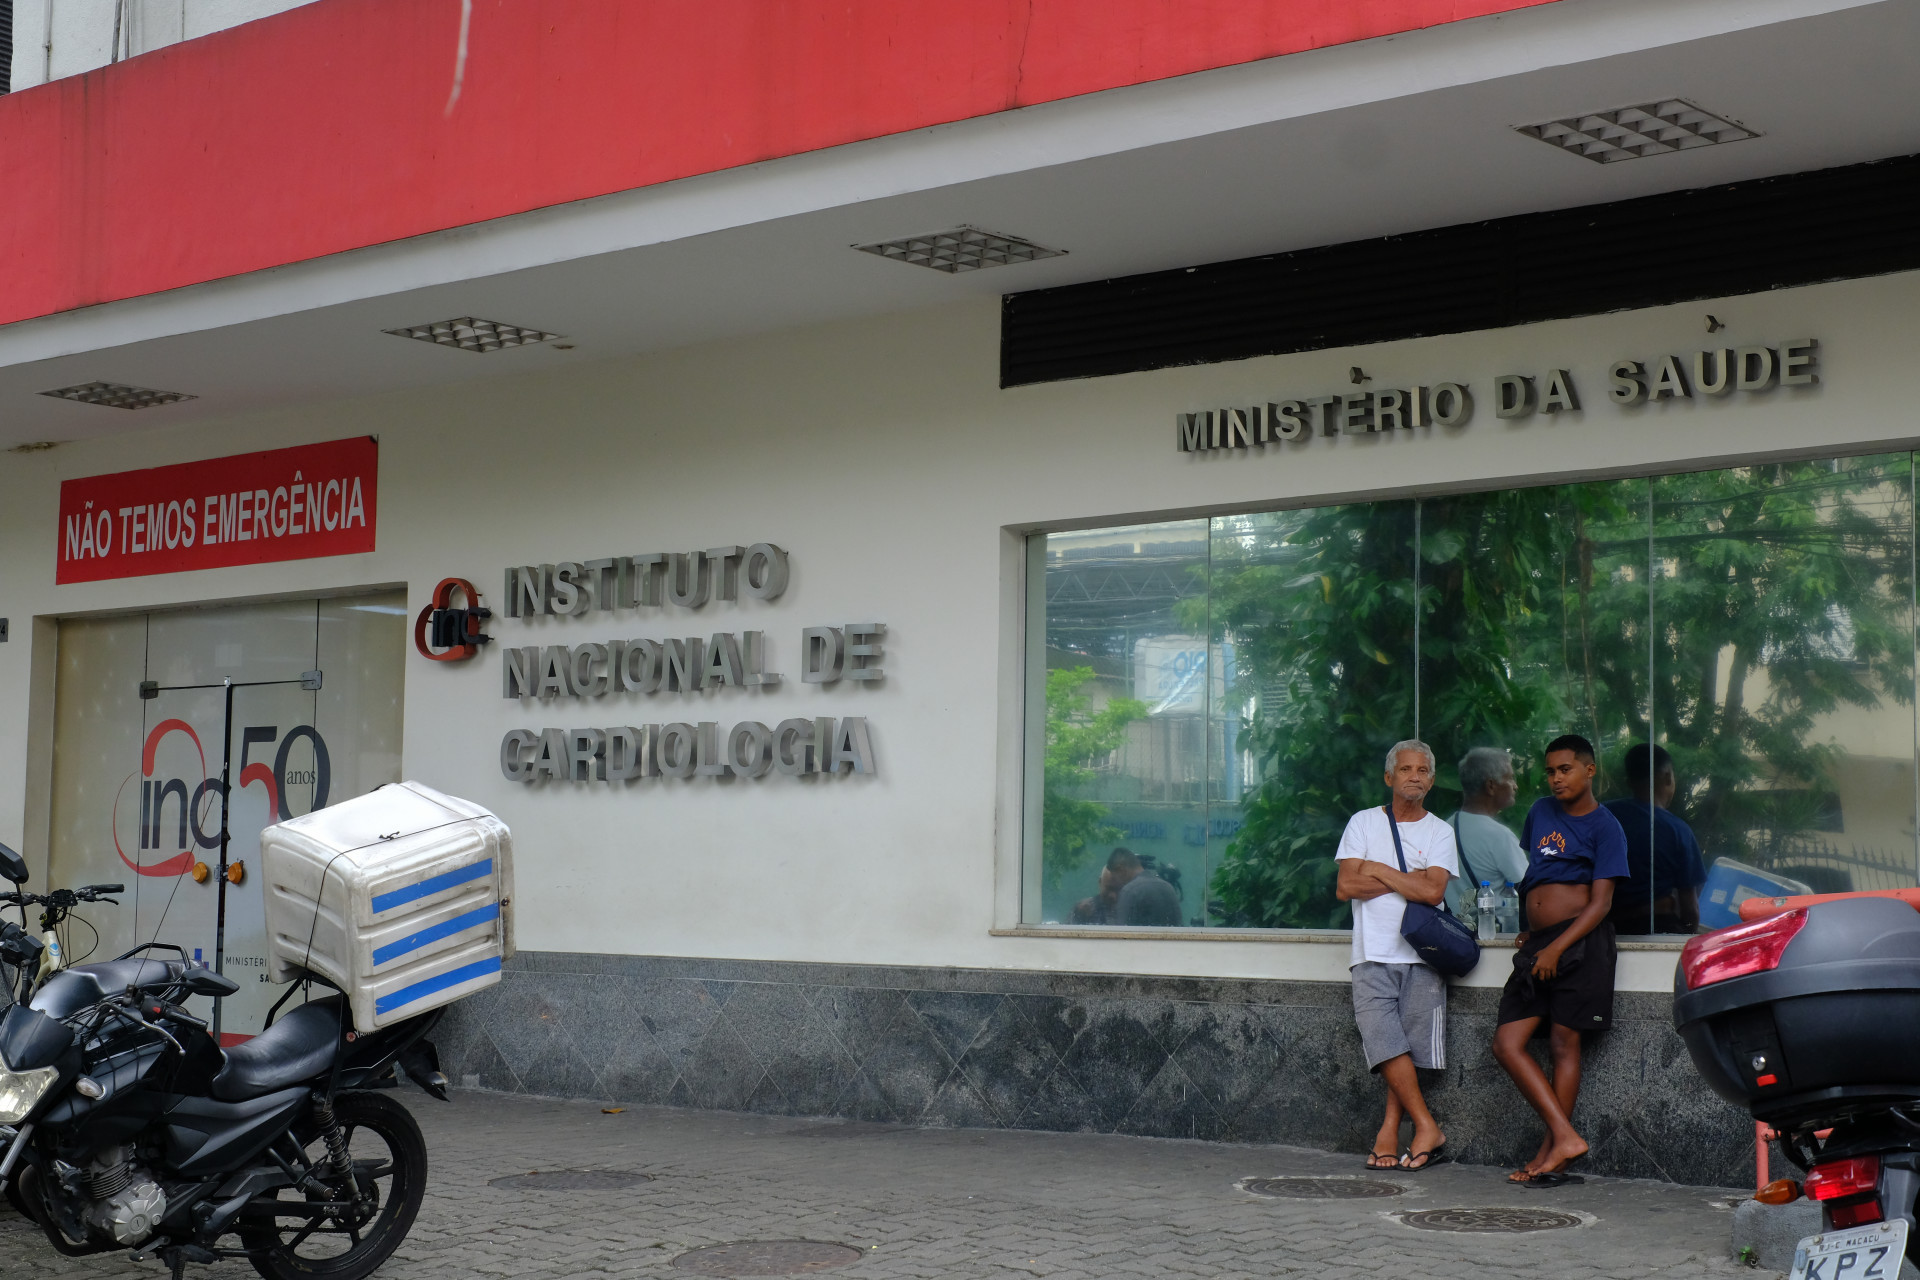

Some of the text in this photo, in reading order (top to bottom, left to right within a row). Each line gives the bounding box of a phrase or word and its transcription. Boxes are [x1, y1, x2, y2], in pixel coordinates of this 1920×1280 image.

[1177, 314, 1819, 453] MINISTÉRIO DA SAÚDE
[65, 470, 366, 561] NÃO TEMOS EMERGÊNCIA
[504, 542, 789, 618] INSTITUTO
[502, 623, 886, 699] NACIONAL DE
[240, 725, 331, 826] 50
[286, 769, 316, 786] anos
[500, 716, 875, 782] CARDIOLOGIA
[225, 956, 267, 968] MINISTÉRI
[1804, 1246, 1890, 1280] KPZ
[1846, 1234, 1880, 1247] MACACU
